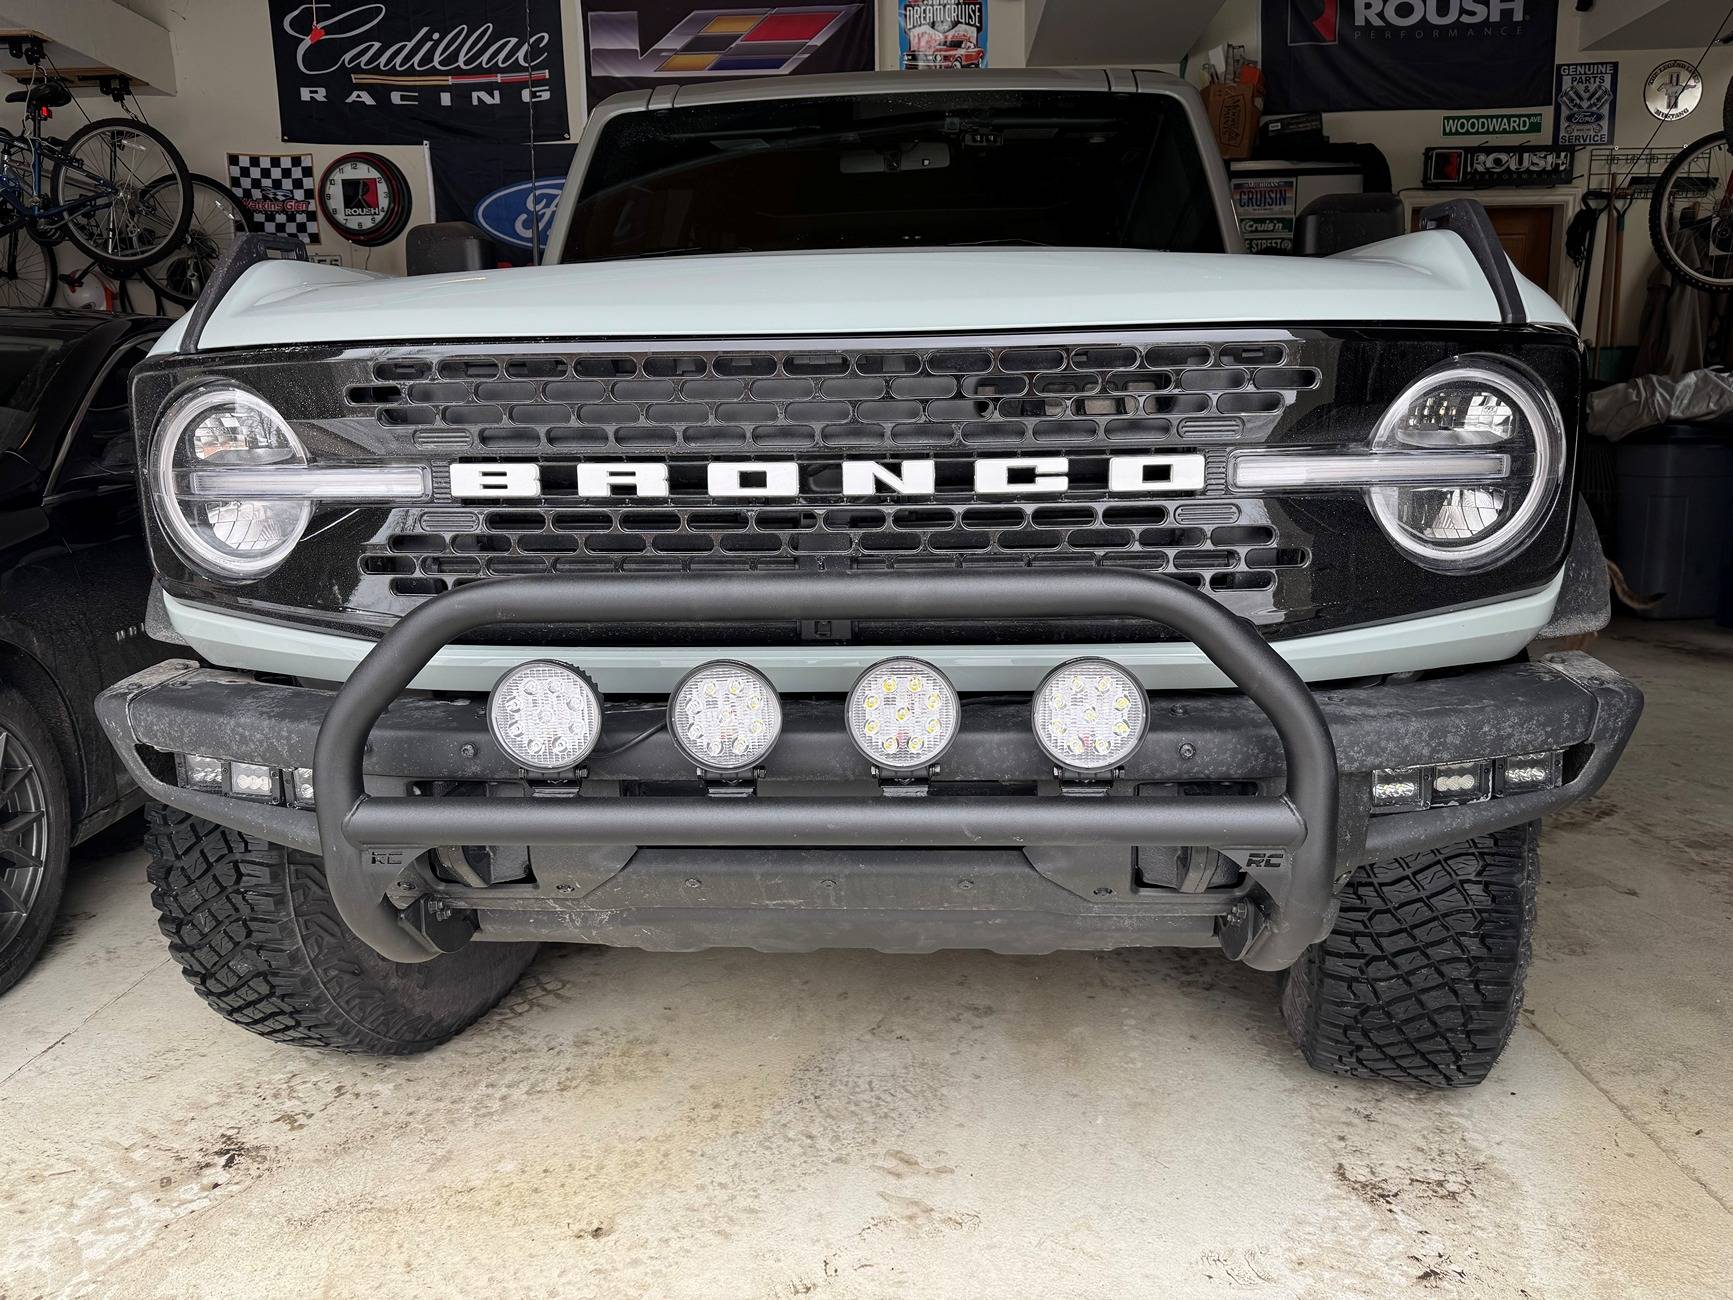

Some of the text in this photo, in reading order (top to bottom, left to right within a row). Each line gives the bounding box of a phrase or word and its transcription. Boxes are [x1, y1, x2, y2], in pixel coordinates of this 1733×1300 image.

[906, 4, 980, 29] DREAM CRUISE
[1354, 0, 1524, 26] ROUSH
[283, 3, 550, 75] Cadillac
[1354, 26, 1523, 40] PERFORMANCE
[1561, 64, 1614, 75] GENUINE
[1571, 75, 1605, 85] PARTS
[300, 86, 550, 106] RACING
[1444, 117, 1530, 133] WOODWARD
[1572, 112, 1597, 122] Ford
[1560, 133, 1606, 143] SERVICE
[1467, 151, 1570, 172] ROUSH
[284, 199, 309, 211] Glen
[1240, 188, 1287, 207] CRUISIN
[345, 208, 379, 216] ROUSH
[449, 454, 1206, 498] BRONCO
[1246, 852, 1284, 868] RC
